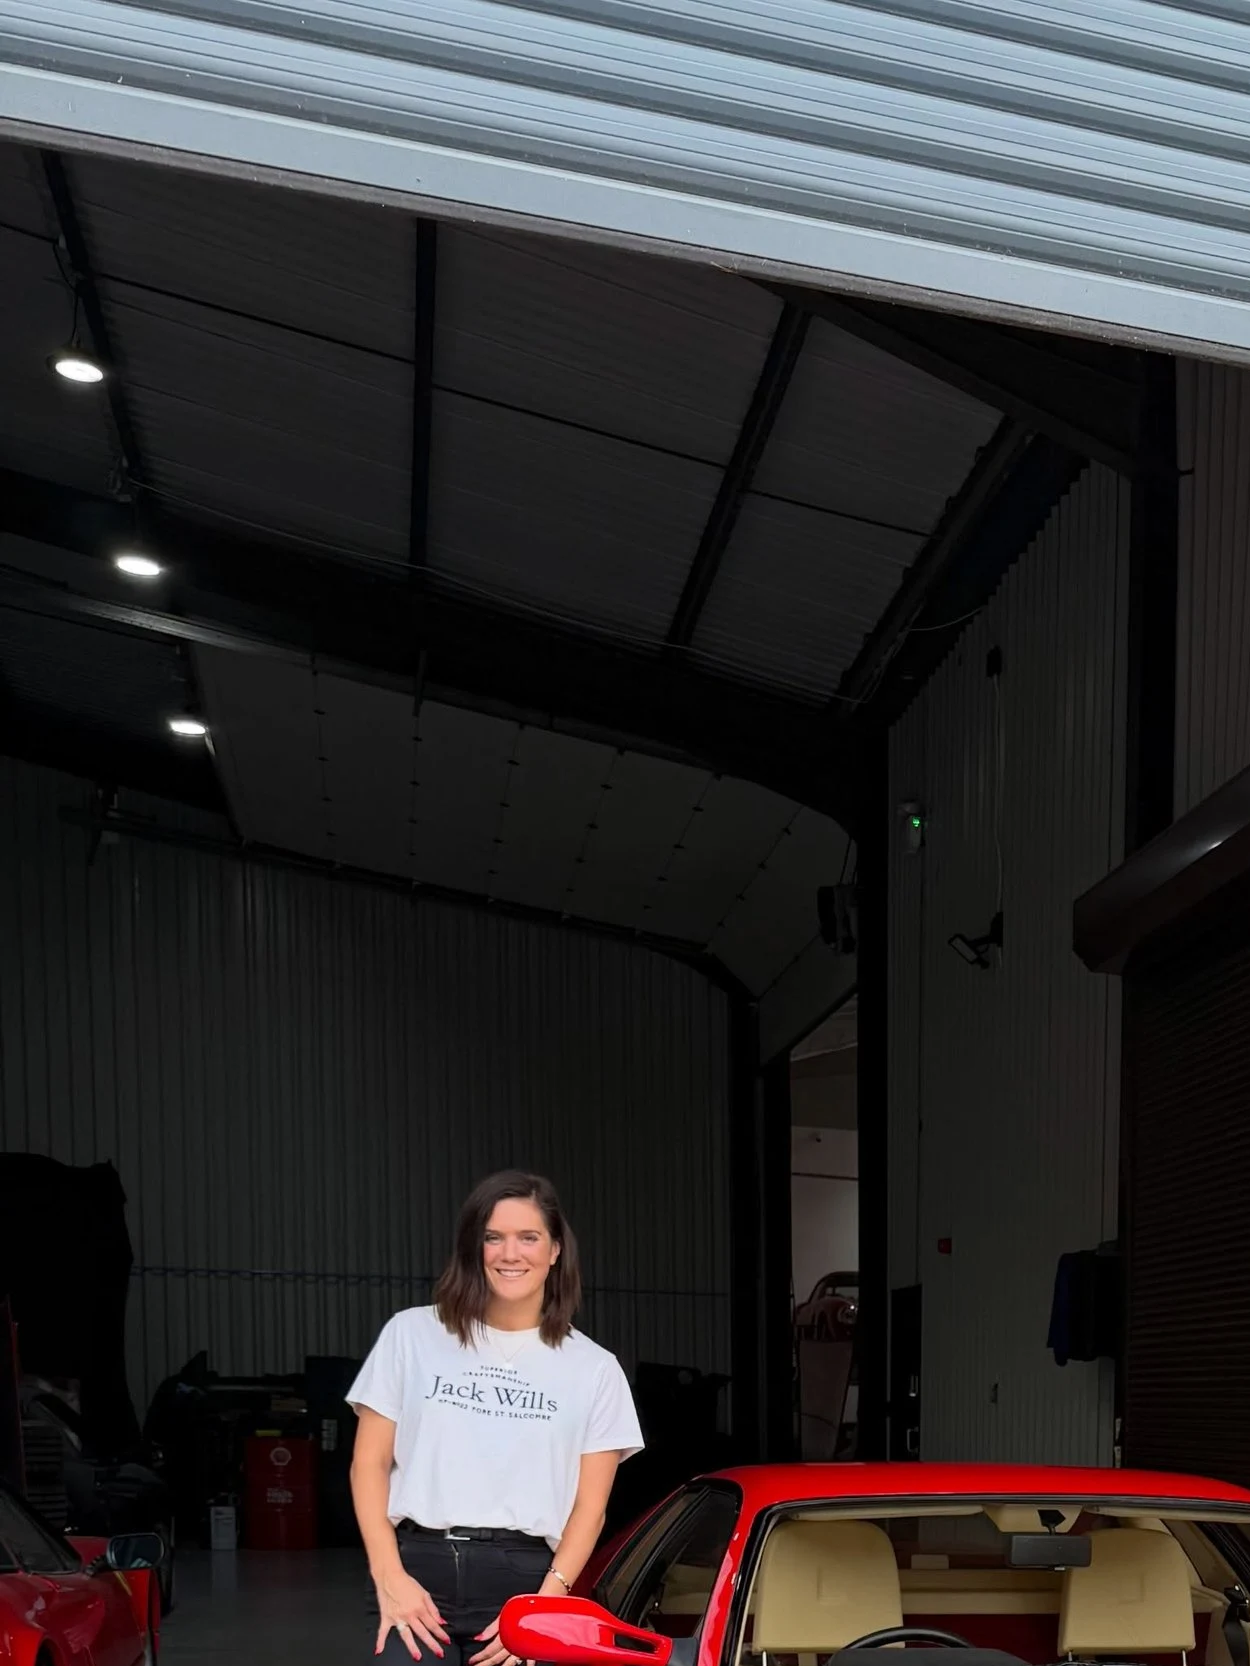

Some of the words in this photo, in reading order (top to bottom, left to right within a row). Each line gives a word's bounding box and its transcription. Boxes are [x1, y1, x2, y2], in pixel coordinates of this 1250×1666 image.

[424, 1374, 486, 1404] Jack
[493, 1386, 559, 1413] Wills
[471, 1406, 492, 1417] FORE
